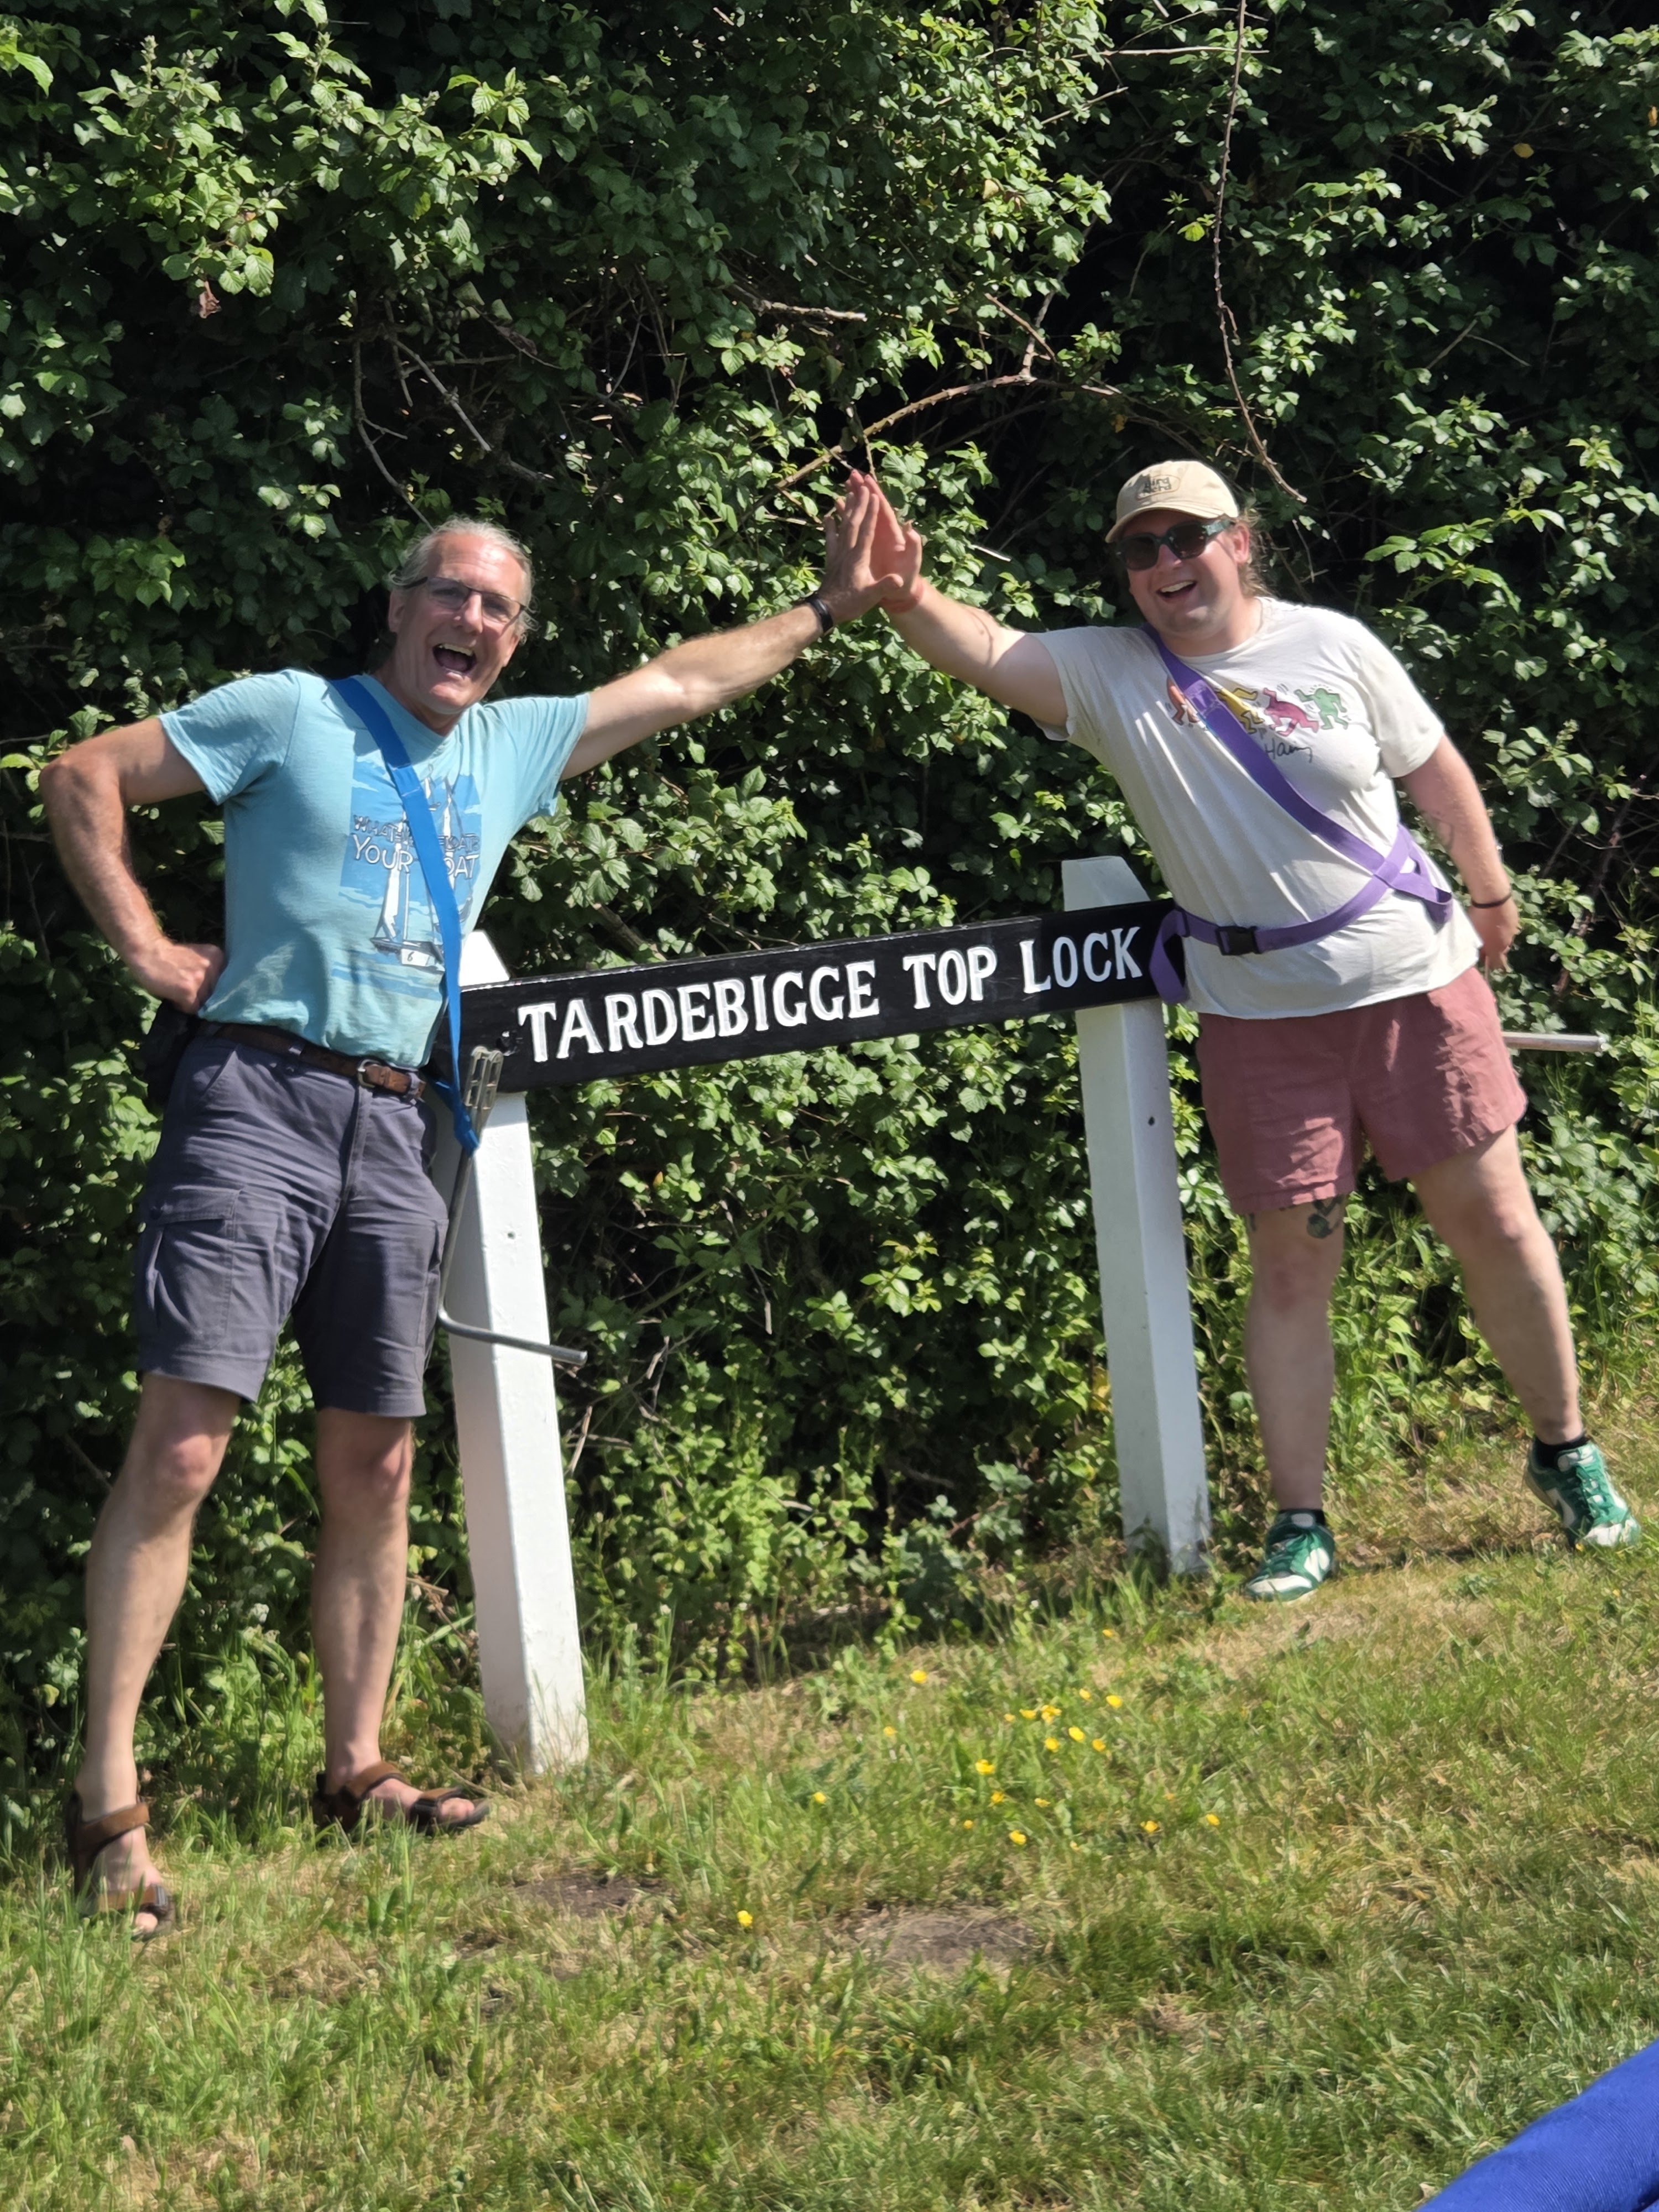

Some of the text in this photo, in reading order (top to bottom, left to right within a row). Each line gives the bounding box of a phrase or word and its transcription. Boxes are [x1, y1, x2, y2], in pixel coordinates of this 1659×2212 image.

[351, 832, 480, 880] YOUR OAT
[518, 926, 1143, 1063] TARDEBIGGE TOP LOCK
